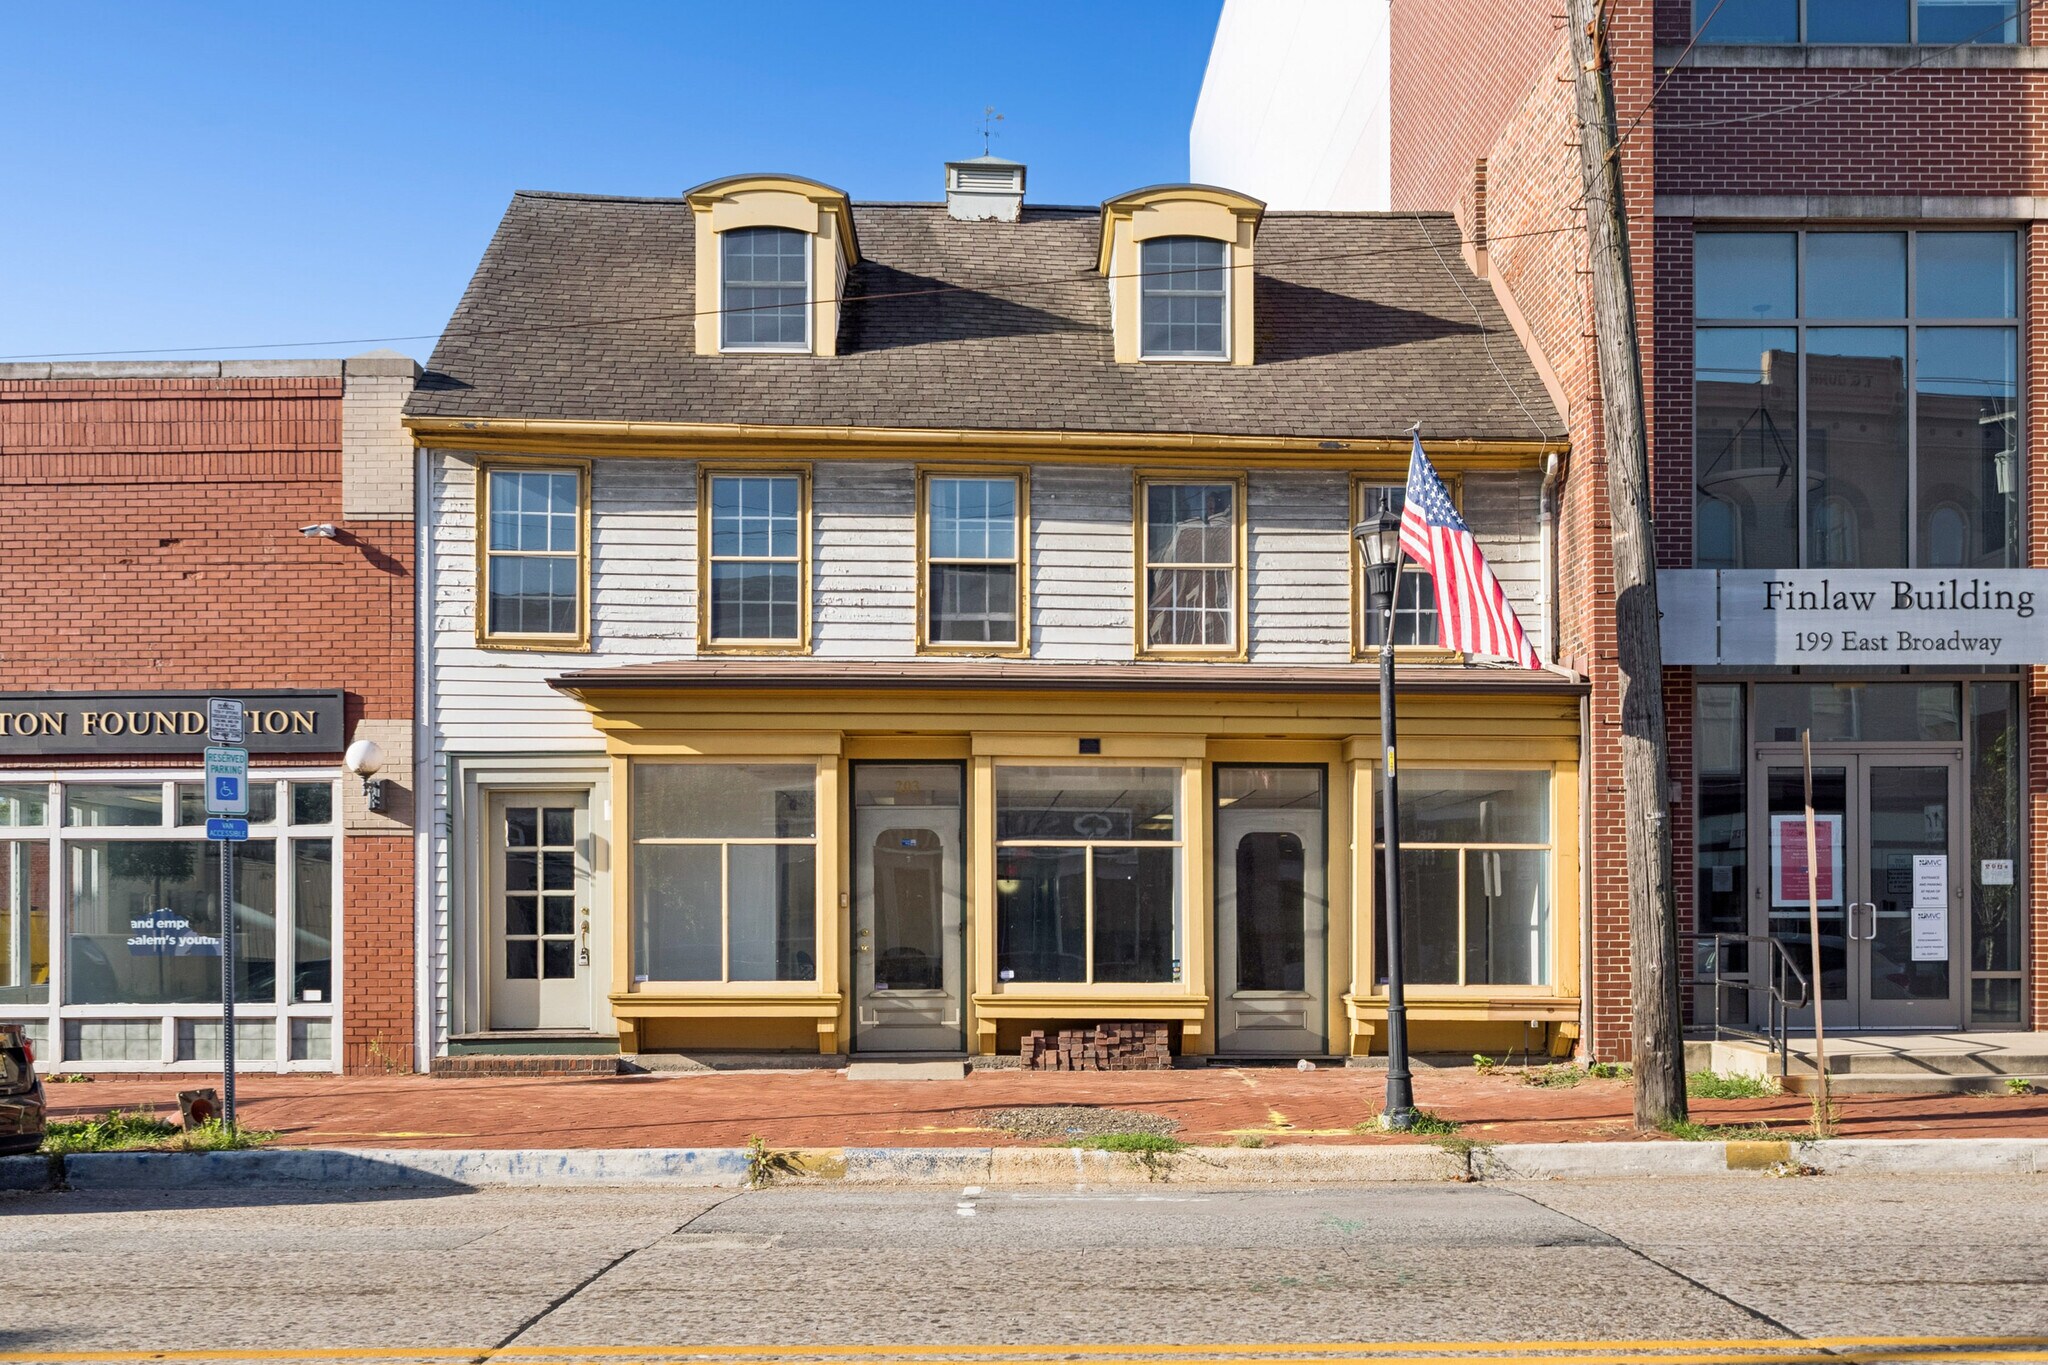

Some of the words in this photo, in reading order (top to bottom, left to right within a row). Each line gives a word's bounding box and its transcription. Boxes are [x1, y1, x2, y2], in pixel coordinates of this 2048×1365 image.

[1763, 579, 1877, 611] Finlaw
[1891, 579, 2036, 618] Building
[1795, 631, 1833, 652] 199
[1841, 631, 1888, 652] East
[1897, 630, 2002, 656] Broadway
[81, 710, 317, 736] FOUNDION
[207, 753, 245, 763] RESERVED
[210, 764, 243, 775] PARKING
[221, 822, 234, 830] VAN
[209, 829, 246, 838] ACCESSIBLE
[130, 918, 154, 929] and
